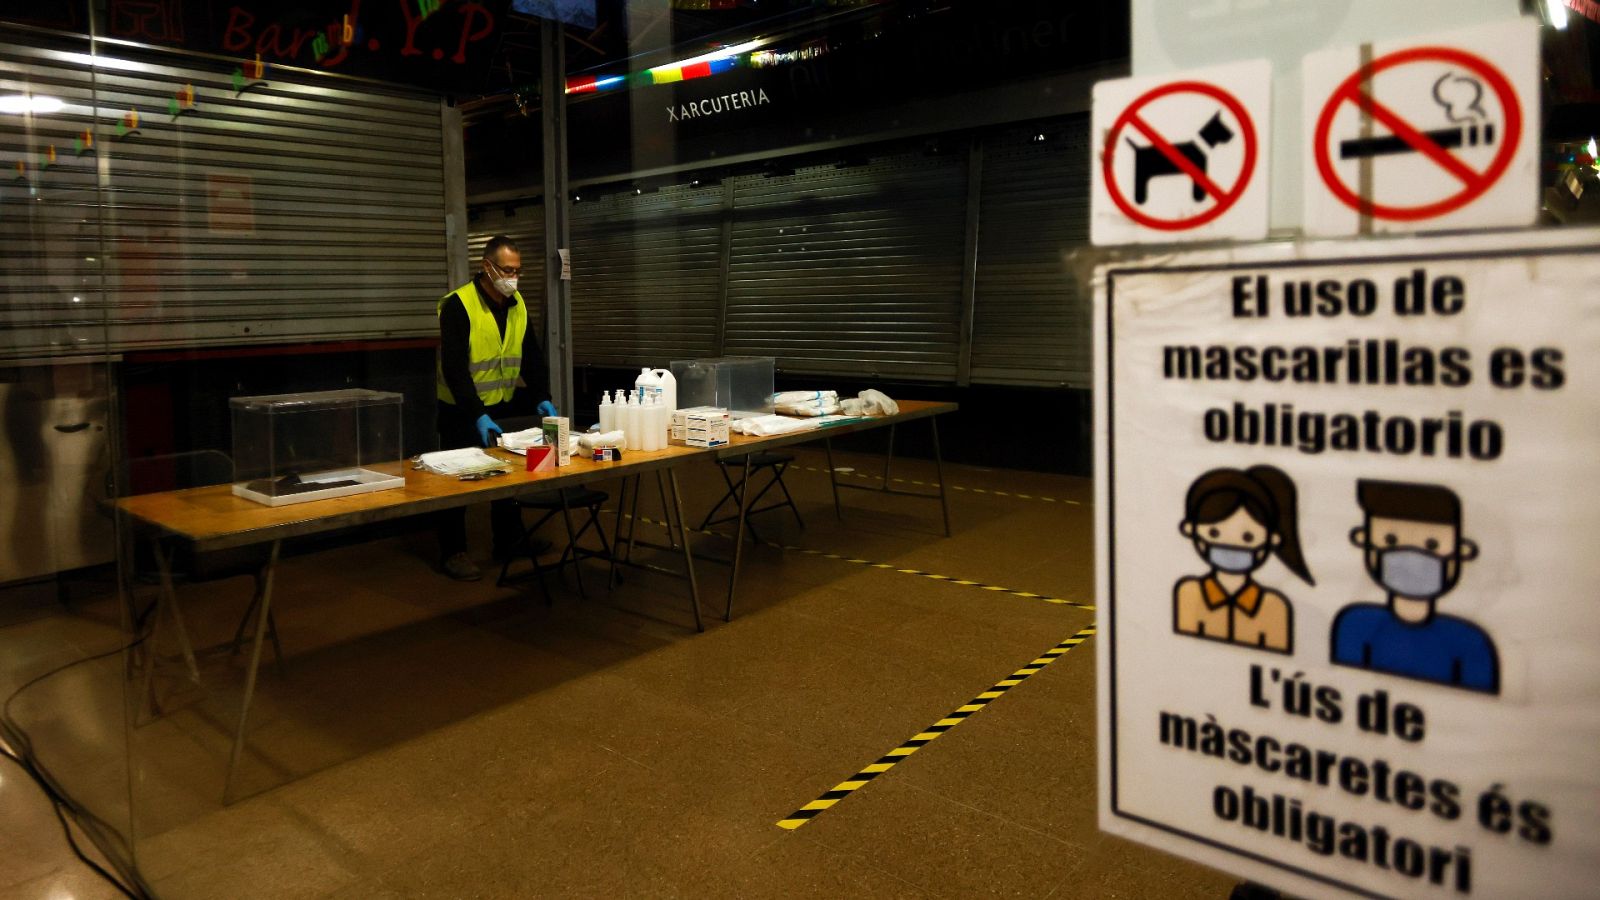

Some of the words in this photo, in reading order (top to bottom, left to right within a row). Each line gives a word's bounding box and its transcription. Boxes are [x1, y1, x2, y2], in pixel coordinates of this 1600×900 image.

[666, 87, 771, 122] XARCUTERIA
[1232, 275, 1269, 318] El
[1283, 276, 1378, 318] uso
[1394, 269, 1466, 316] de
[1163, 339, 1472, 387] mascarillas
[1489, 346, 1567, 390] es
[1204, 402, 1504, 461] obligatorio
[1249, 664, 1344, 725] L'ús
[1357, 690, 1426, 743] de
[1159, 711, 1463, 822] màscaretes
[1477, 783, 1553, 847] és
[1213, 785, 1472, 895] obligatori
